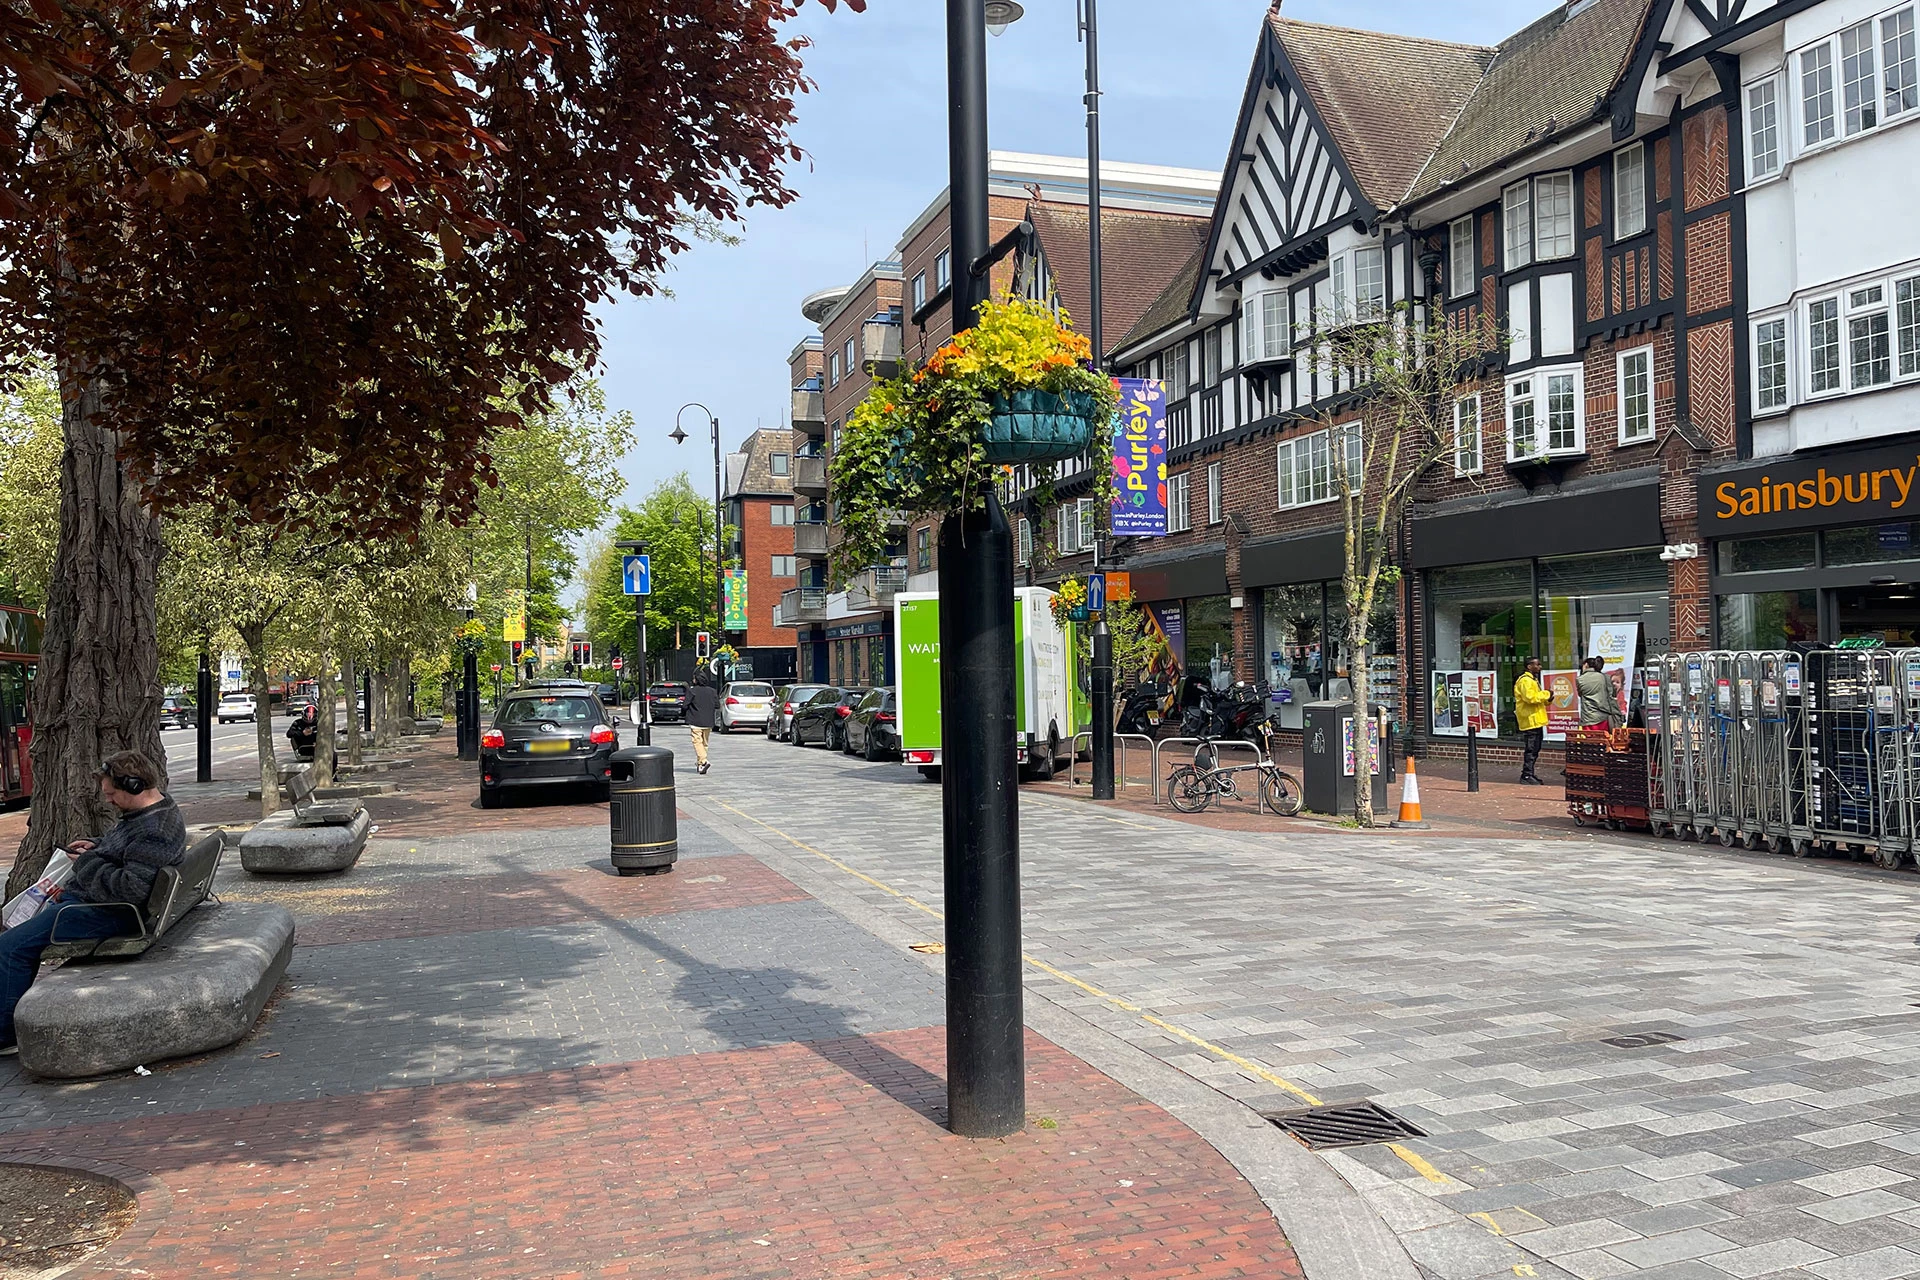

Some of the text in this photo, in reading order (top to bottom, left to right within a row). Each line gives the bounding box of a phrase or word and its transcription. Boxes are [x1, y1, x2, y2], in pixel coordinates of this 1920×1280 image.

[1127, 400, 1152, 491] Purley
[731, 577, 742, 611] Purley
[1449, 687, 1463, 698] £12
